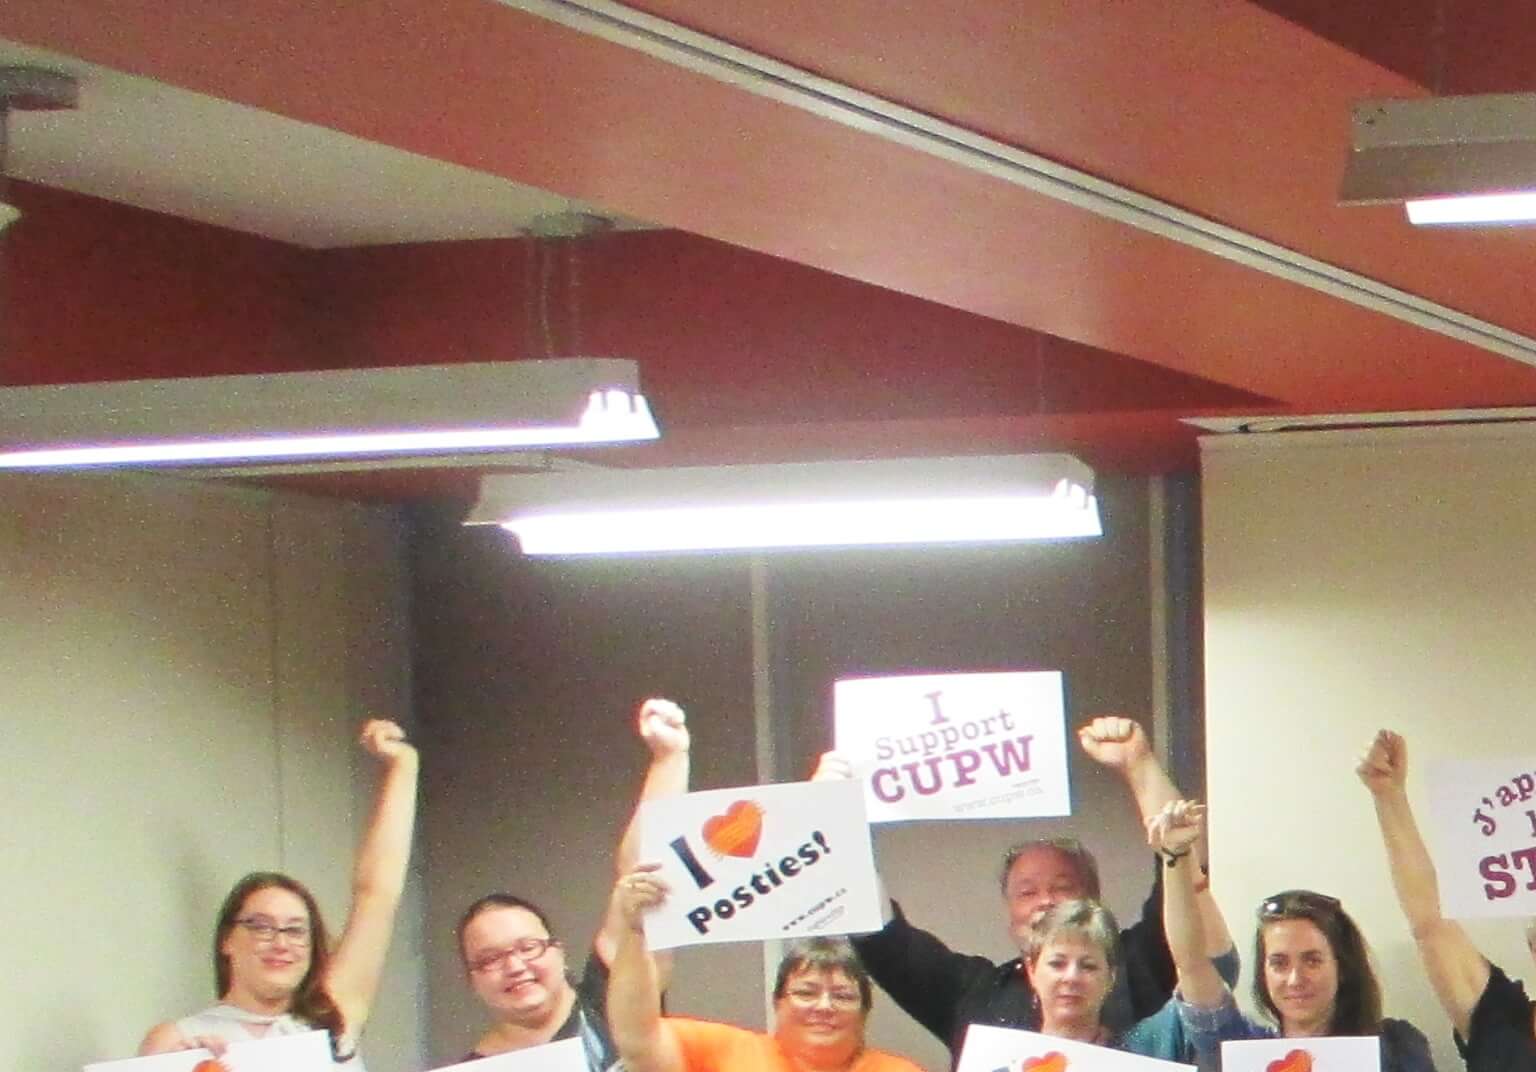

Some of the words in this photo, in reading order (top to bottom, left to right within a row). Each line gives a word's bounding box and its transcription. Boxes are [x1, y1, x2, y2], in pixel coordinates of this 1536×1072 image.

[876, 709, 1015, 760] Support
[924, 691, 949, 726] I
[872, 735, 1034, 803] CUPW
[670, 836, 715, 889] I
[687, 830, 830, 934] Posties!
